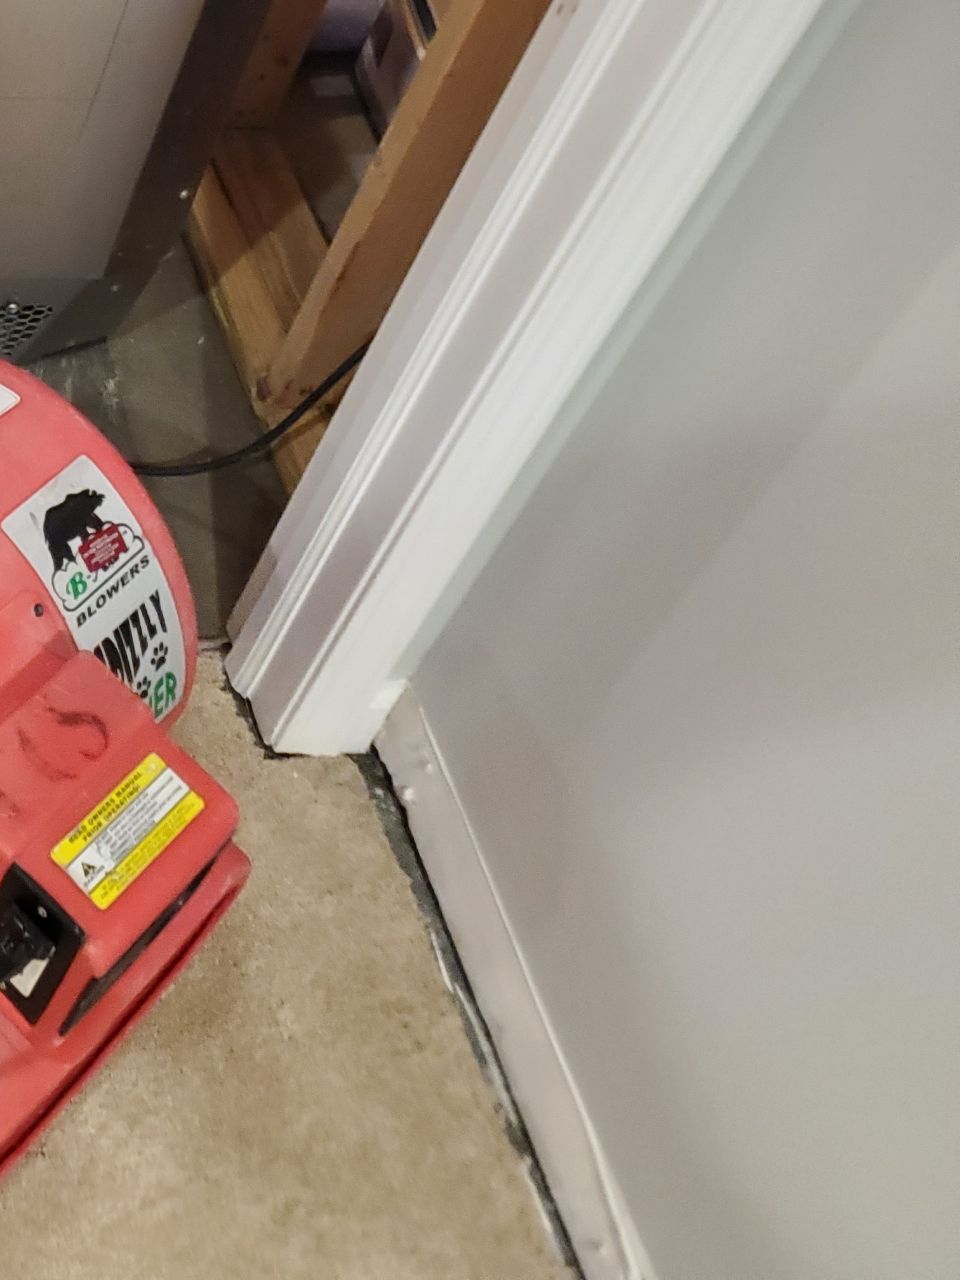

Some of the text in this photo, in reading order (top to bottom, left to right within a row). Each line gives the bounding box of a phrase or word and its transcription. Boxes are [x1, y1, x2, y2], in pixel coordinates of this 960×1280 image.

[76, 555, 150, 628] BLOWERS
[87, 796, 116, 826] OWNERS
[115, 771, 142, 798] MANUAL
